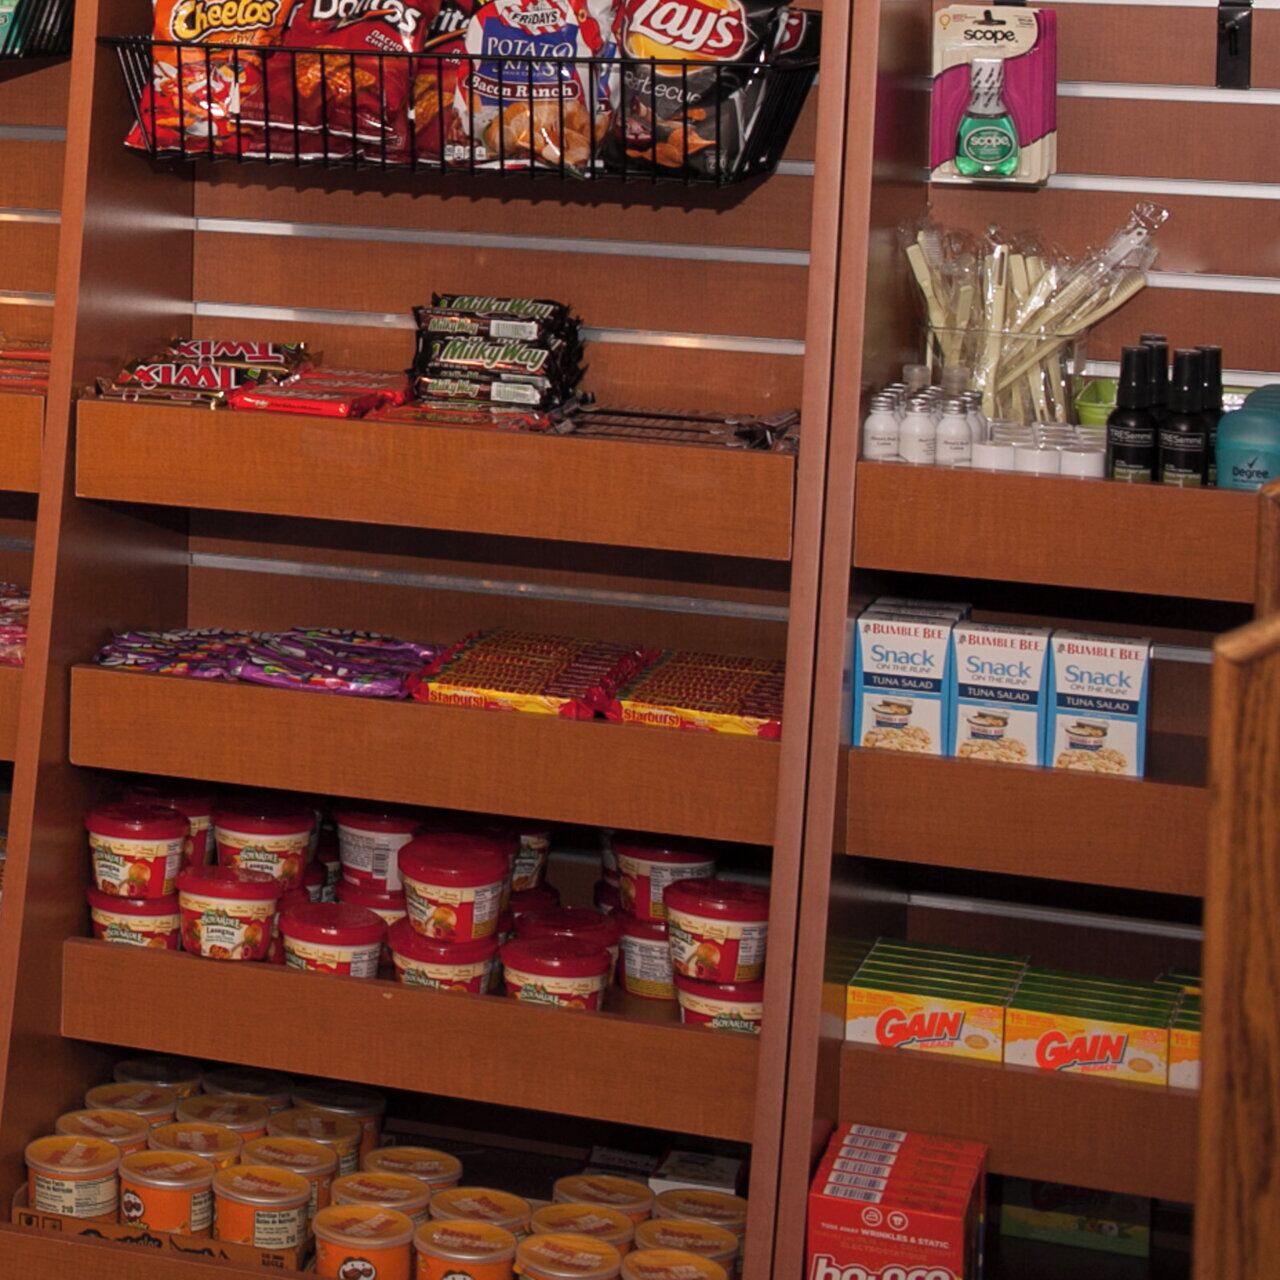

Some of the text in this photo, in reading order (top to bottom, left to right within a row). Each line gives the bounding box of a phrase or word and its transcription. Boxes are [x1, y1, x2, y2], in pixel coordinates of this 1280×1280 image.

[964, 29, 1015, 44] scope
[440, 338, 549, 371] Milky Way
[1232, 465, 1270, 480] Degree
[872, 623, 943, 640] BUMBLE BEE
[968, 633, 1040, 652] BUMBLE BEE
[1067, 643, 1141, 662] BUMBLE BEE
[871, 644, 935, 668] Snack
[966, 655, 1032, 680] Snack
[1065, 665, 1132, 690] Snack
[872, 676, 934, 690] TUNA SALAD
[428, 688, 485, 708] Starburst
[967, 687, 1030, 703] TUNA SALAD
[1066, 696, 1130, 712] TUNA SALAD
[623, 707, 682, 728] Starburst
[875, 1007, 967, 1048] GAIN
[1035, 1030, 1129, 1071] GAIN
[861, 1228, 908, 1244] WRINKLES
[917, 1237, 951, 1249] STATIC
